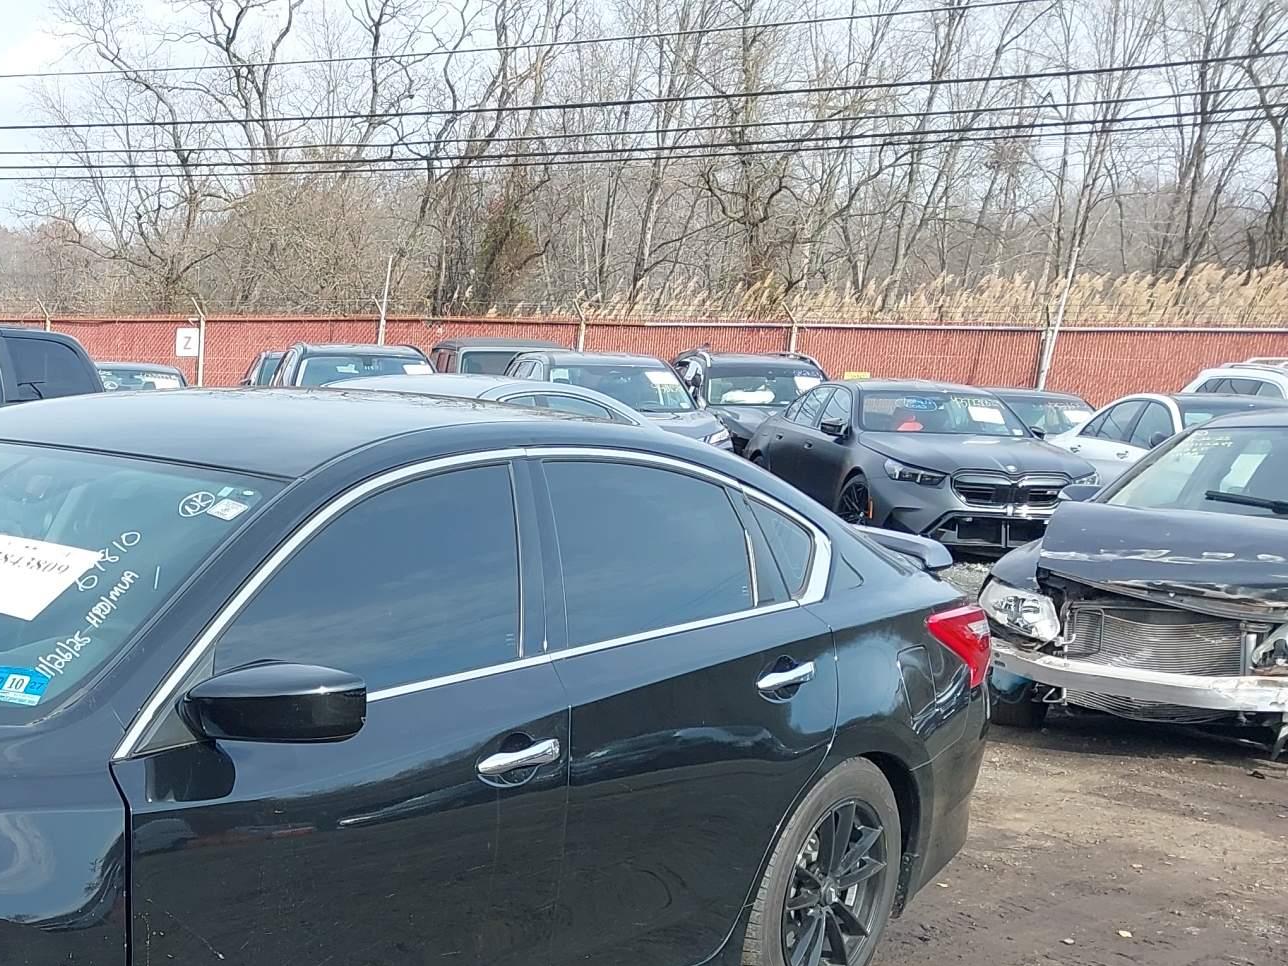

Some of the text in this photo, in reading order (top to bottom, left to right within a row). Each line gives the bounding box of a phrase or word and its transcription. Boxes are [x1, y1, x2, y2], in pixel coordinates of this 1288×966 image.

[183, 335, 193, 350] Z
[6, 677, 25, 690] 10
[29, 681, 45, 691] 27
